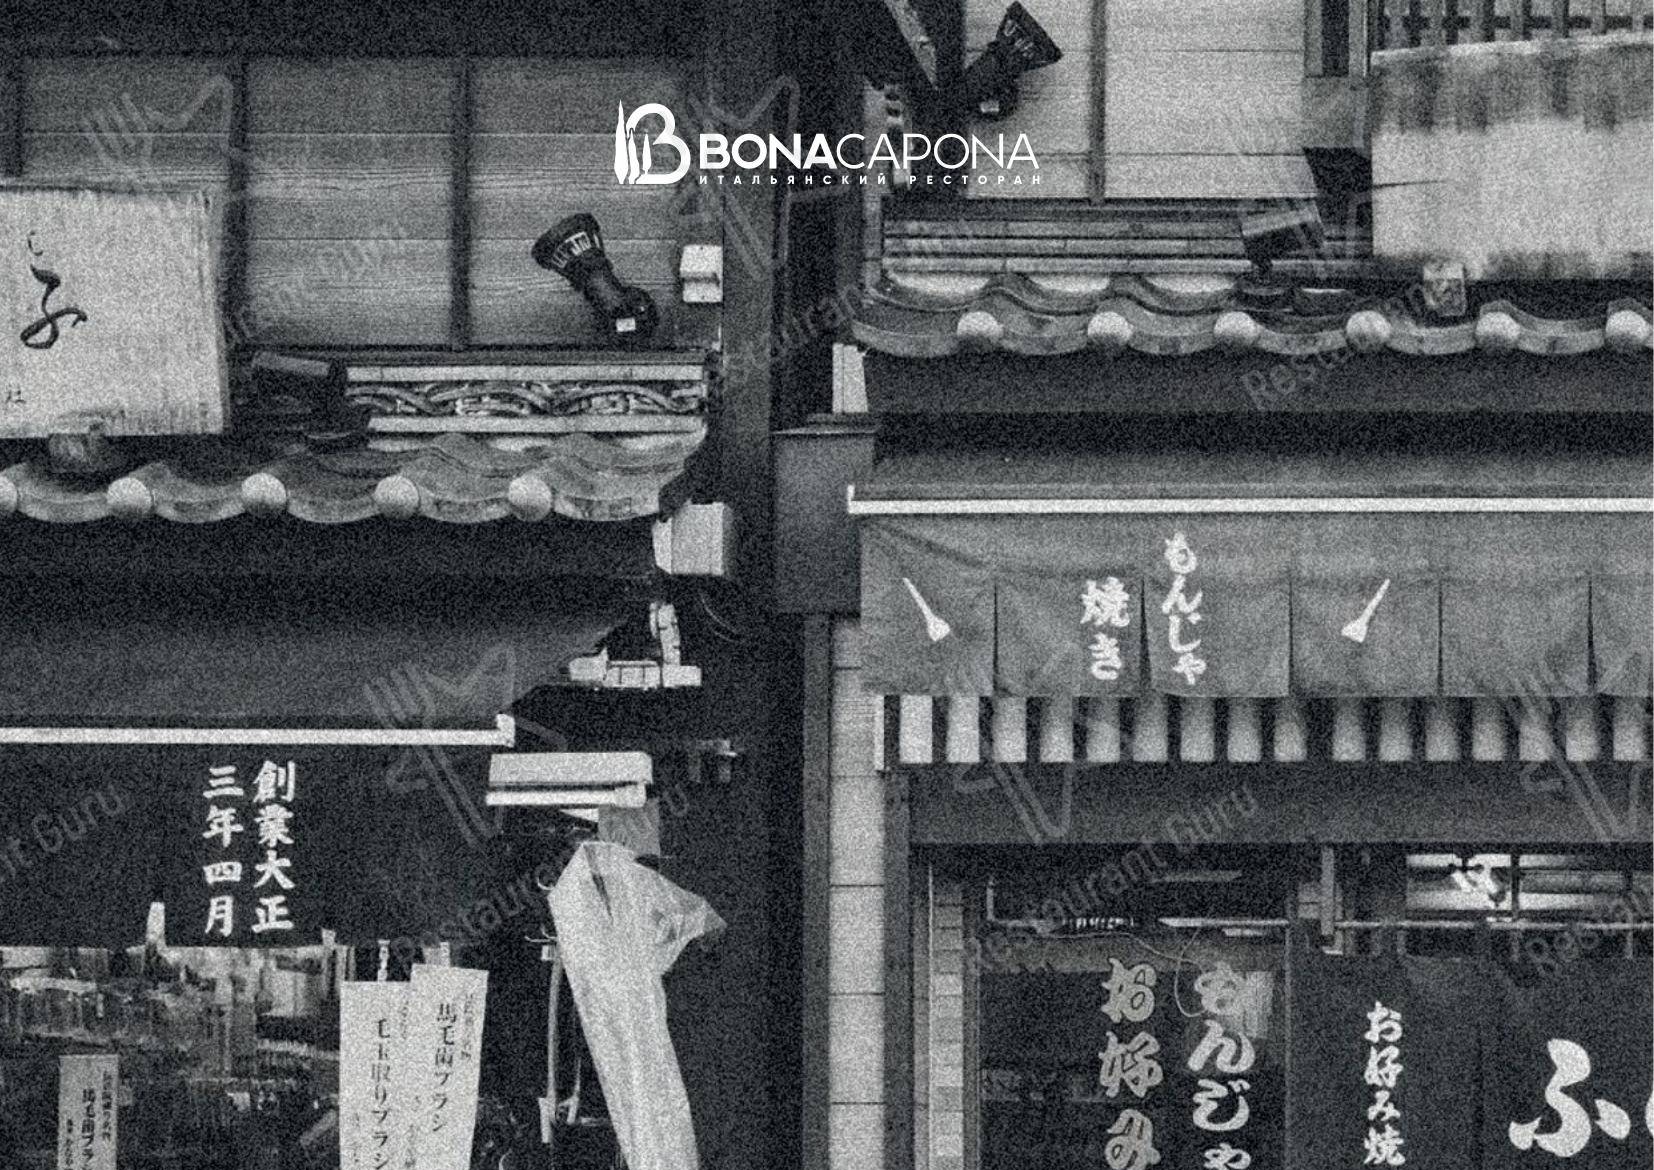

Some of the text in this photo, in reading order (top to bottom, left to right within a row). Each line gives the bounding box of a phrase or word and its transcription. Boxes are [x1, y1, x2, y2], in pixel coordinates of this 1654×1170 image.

[1081, 577, 1130, 680] 焼き
[1161, 532, 1206, 684] もんじゃ
[203, 766, 244, 936] 三年四月
[252, 760, 295, 932] 創業大正
[1364, 1001, 1406, 1165] お好み焼
[1509, 1039, 1654, 1157] ふ
